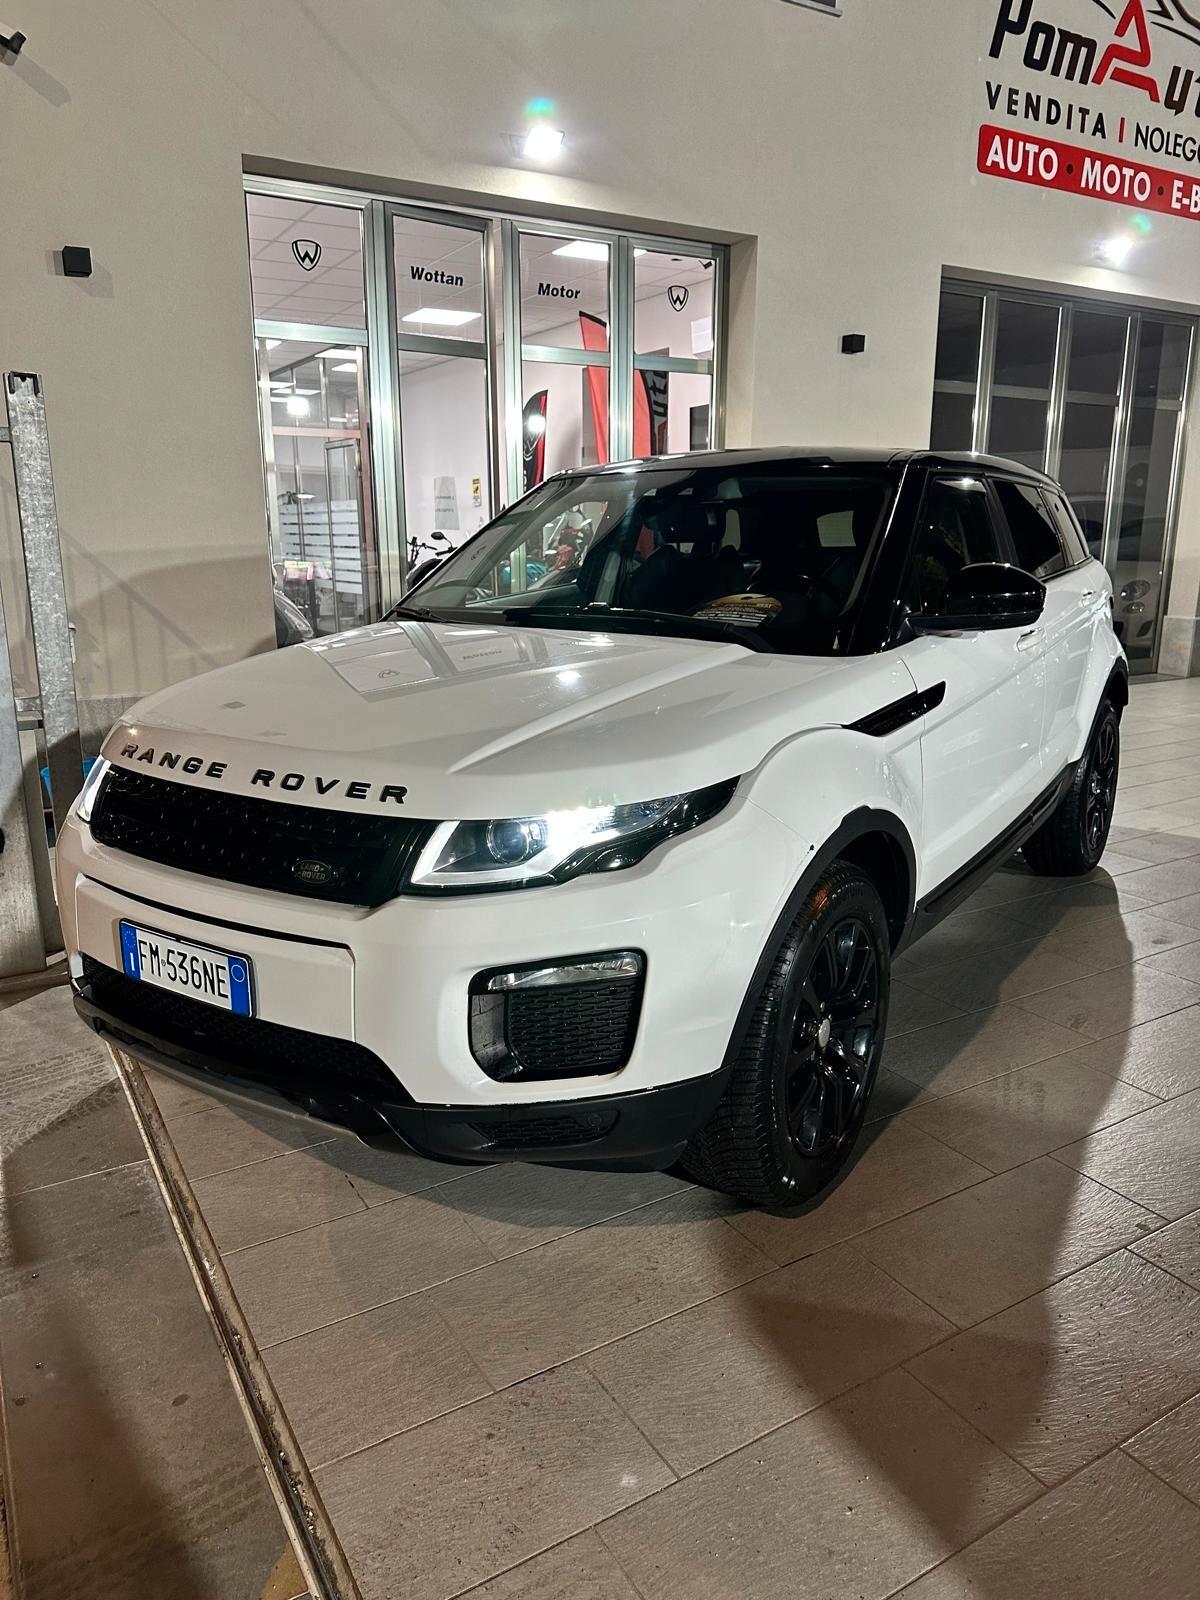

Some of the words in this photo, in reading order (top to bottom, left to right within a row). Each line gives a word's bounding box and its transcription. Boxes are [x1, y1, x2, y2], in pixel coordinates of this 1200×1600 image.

[985, 80, 1107, 140] VENDITA
[1134, 121, 1200, 164] NOLEG
[985, 134, 1059, 181] AUTO
[1080, 156, 1151, 202] MOTO
[410, 265, 464, 287] Wottan
[537, 282, 581, 299] Motor
[120, 743, 228, 779] RANGE
[250, 768, 409, 804] ROVER
[300, 863, 320, 872] LAND
[301, 870, 326, 881] ROVER
